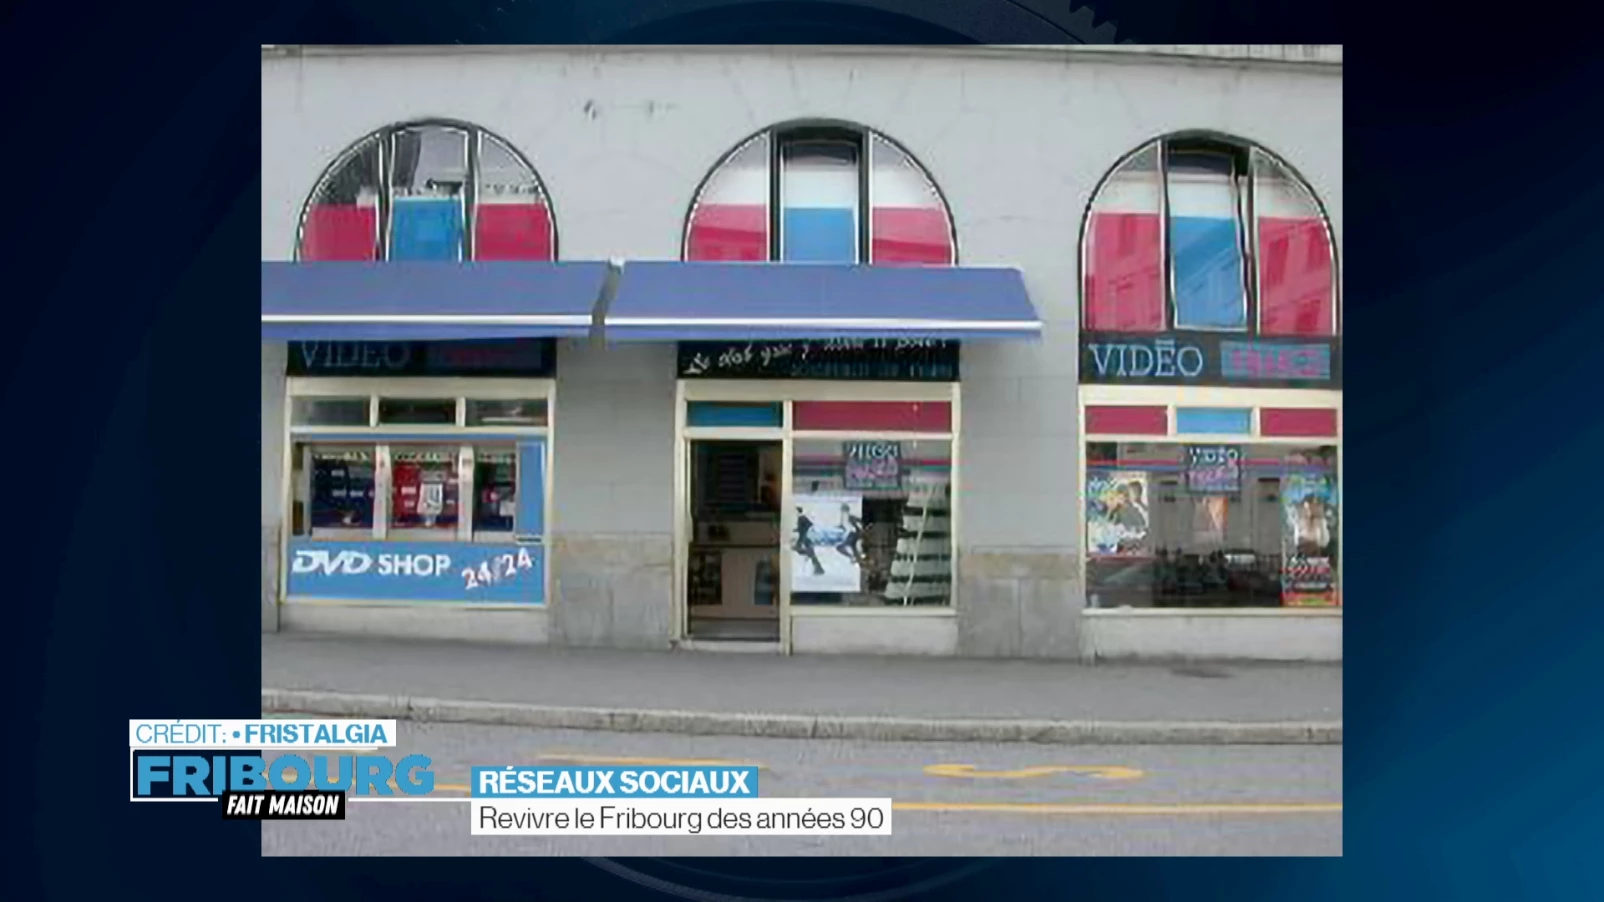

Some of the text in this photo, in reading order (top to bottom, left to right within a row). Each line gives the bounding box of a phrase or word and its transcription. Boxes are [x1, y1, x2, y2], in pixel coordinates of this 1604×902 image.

[291, 547, 533, 590] DVD SHOP 24/24
